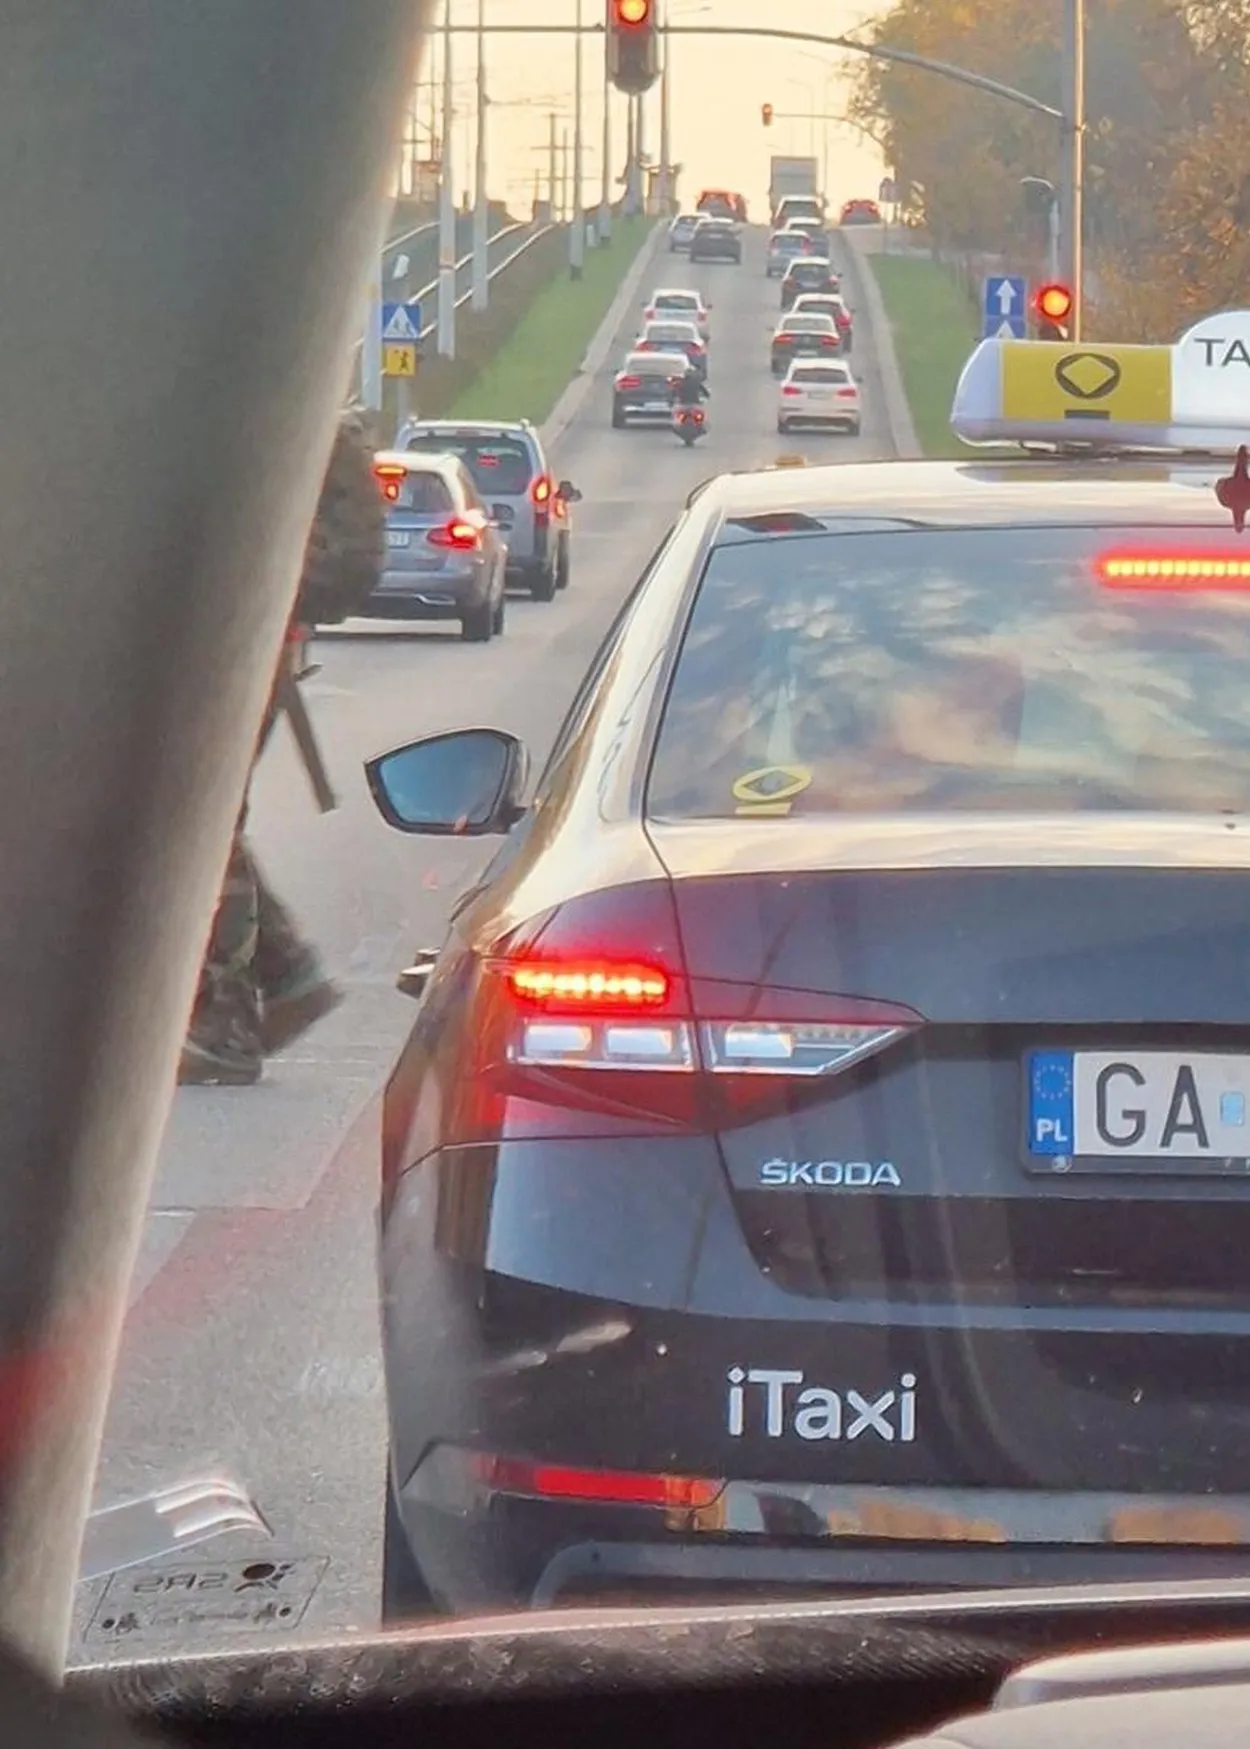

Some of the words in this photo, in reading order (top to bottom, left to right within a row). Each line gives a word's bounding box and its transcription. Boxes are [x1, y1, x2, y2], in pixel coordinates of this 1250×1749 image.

[1036, 1118, 1068, 1143] PL
[1095, 1062, 1210, 1149] GA
[760, 1158, 901, 1186] ŠKODA
[727, 1366, 917, 1442] iTaxi
